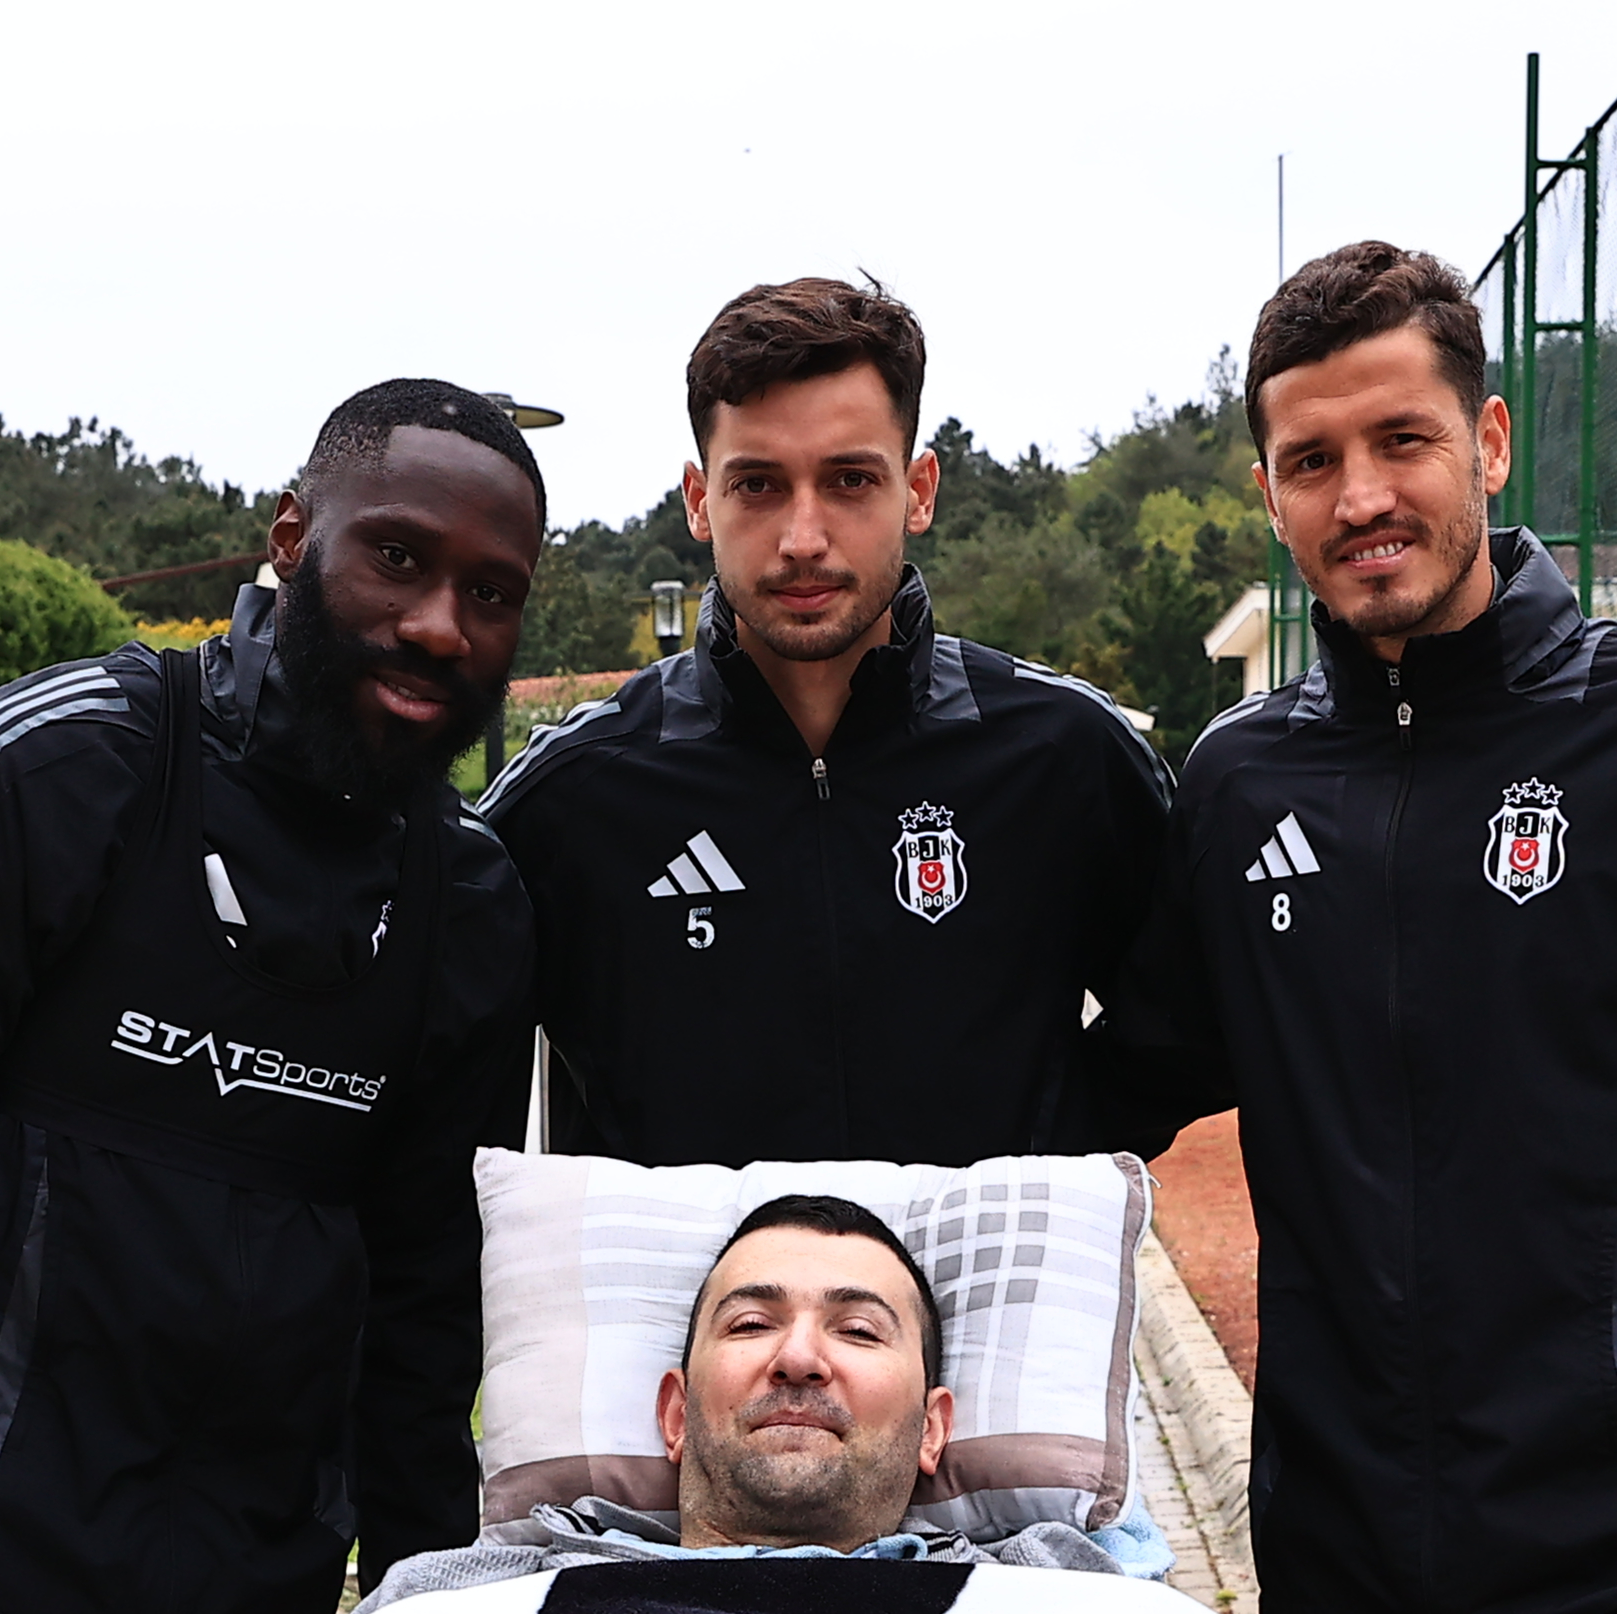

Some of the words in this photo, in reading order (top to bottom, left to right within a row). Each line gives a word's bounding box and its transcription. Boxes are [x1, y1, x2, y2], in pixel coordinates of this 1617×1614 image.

[1504, 816, 1551, 834] BJK
[908, 839, 951, 858] BJK
[1502, 874, 1545, 888] 1903
[915, 894, 953, 908] 1903
[1272, 893, 1291, 931] 8
[688, 907, 714, 948] 5
[116, 1009, 383, 1102] STATSports
